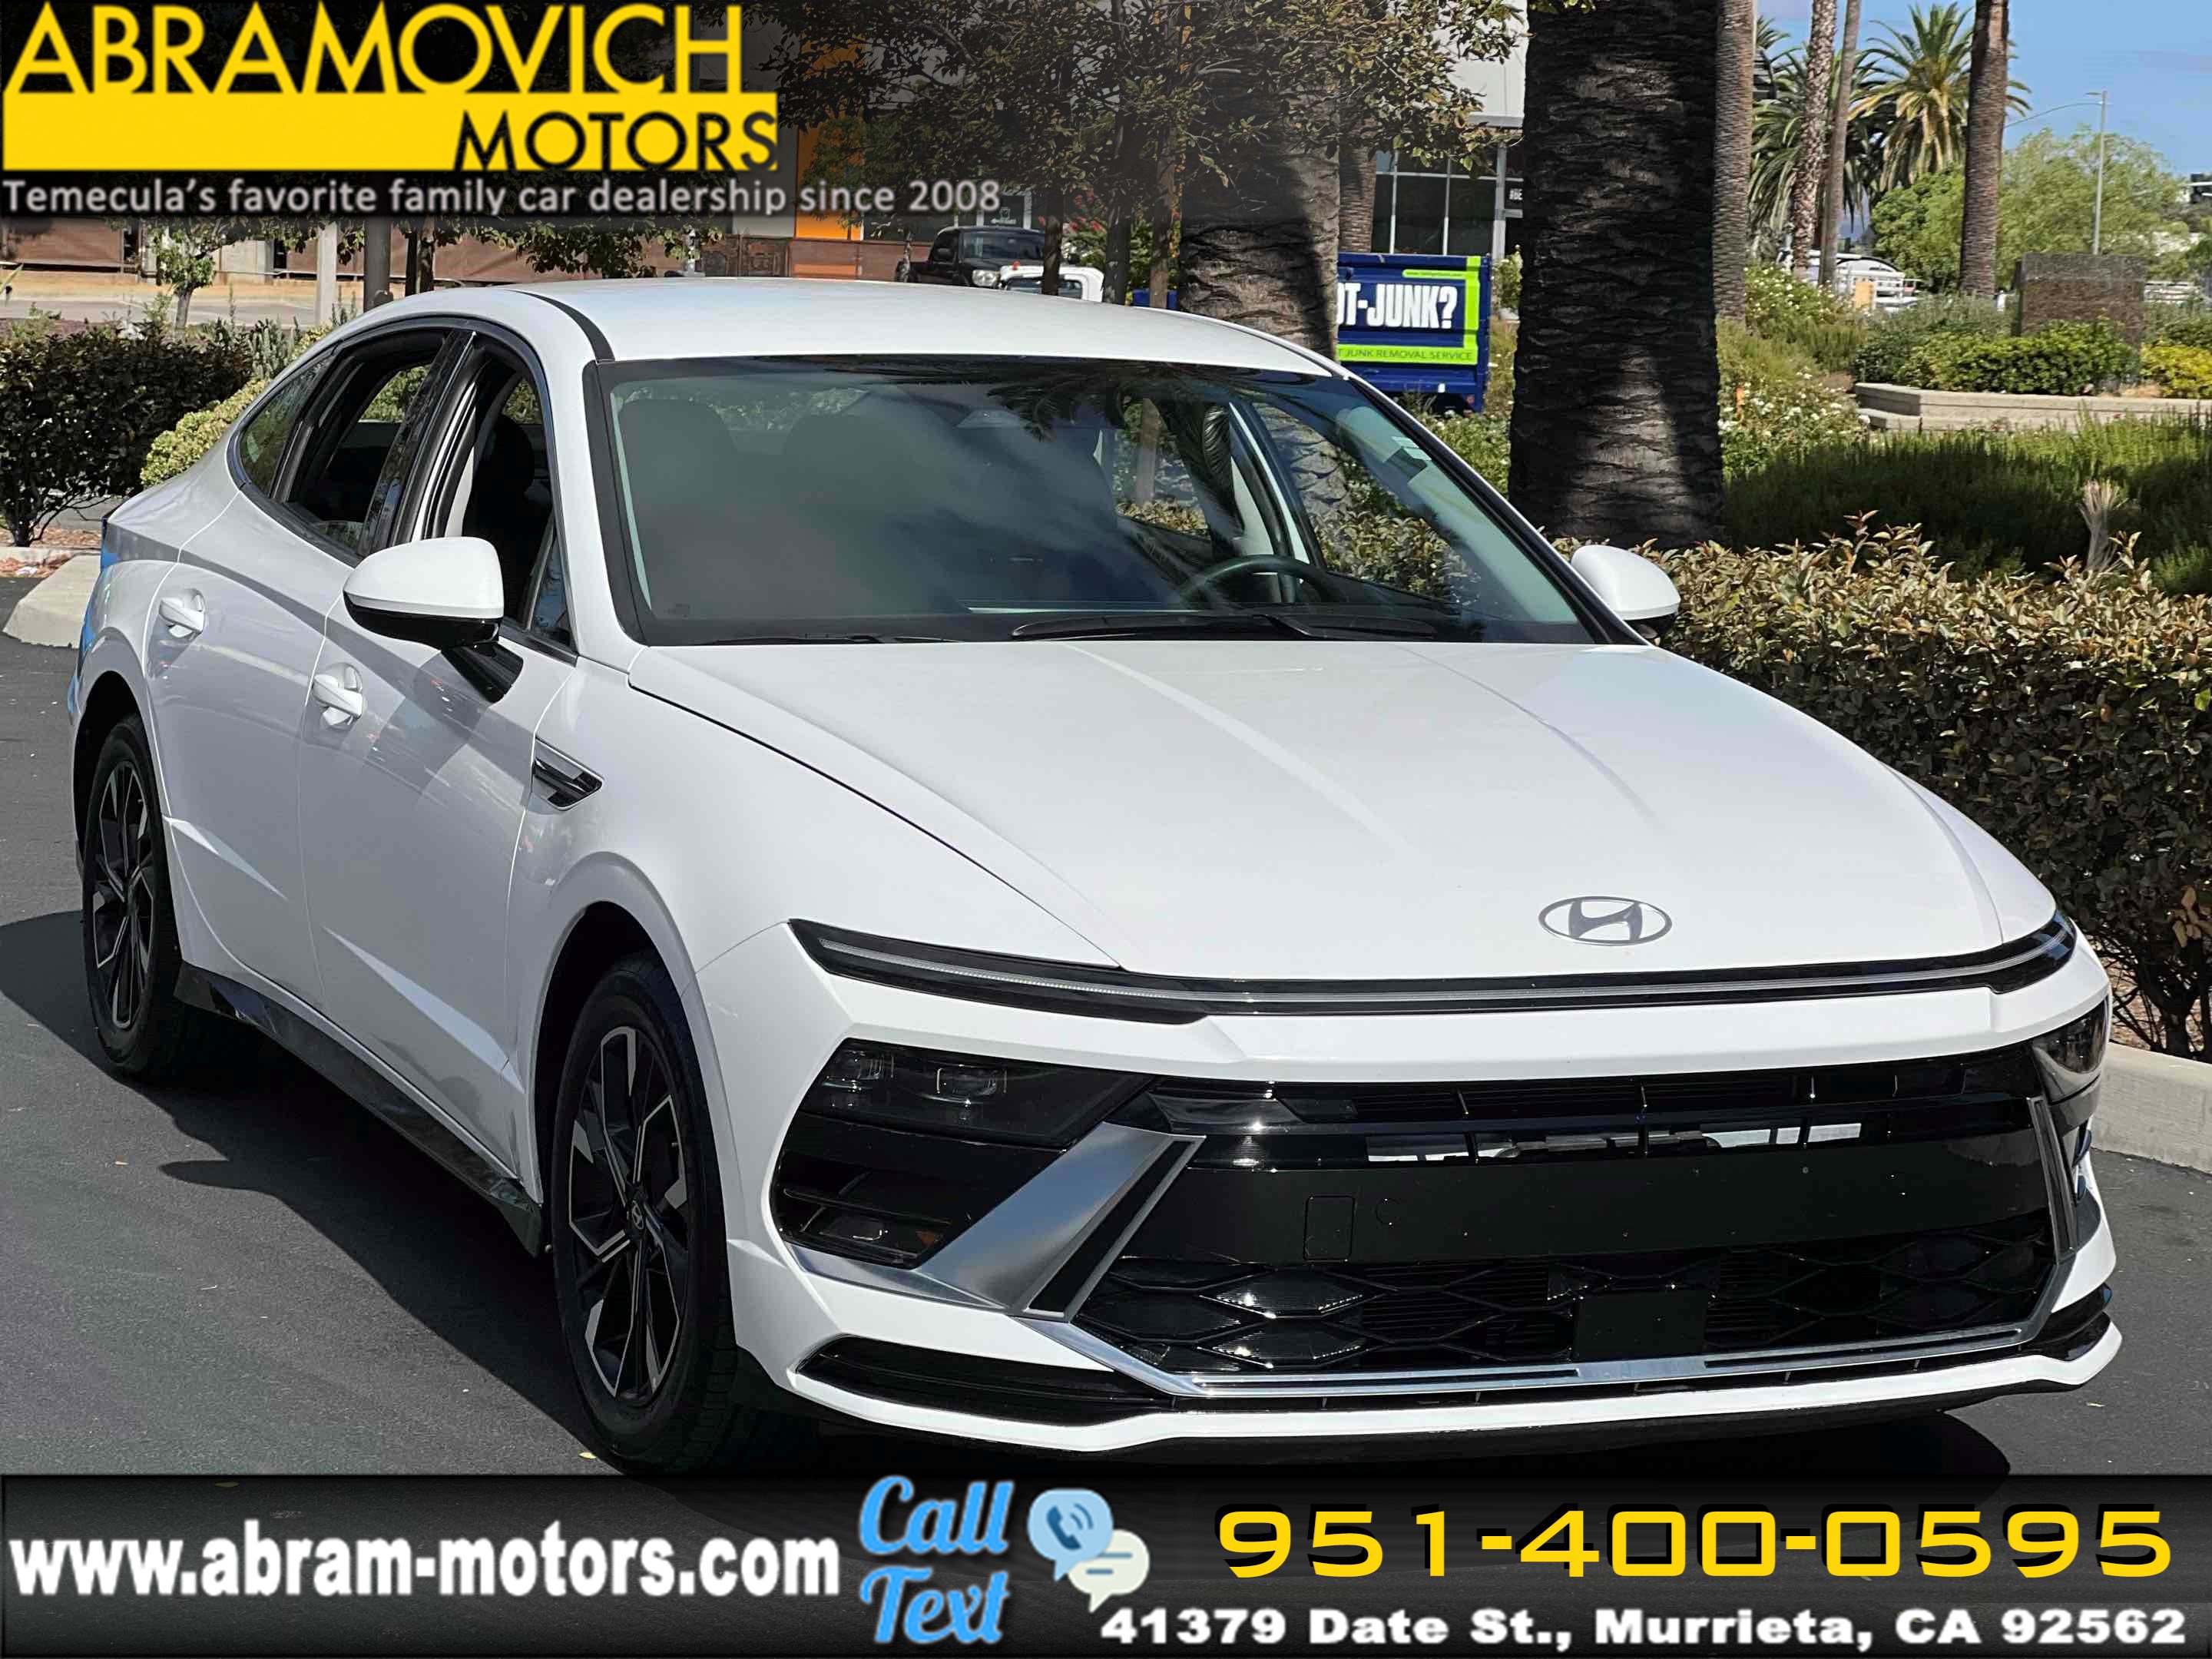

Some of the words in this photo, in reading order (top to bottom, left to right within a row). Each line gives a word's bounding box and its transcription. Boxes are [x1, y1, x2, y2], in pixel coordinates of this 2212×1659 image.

[1346, 349, 1373, 358] JUNK
[1376, 350, 1427, 359] REMOVAL
[1430, 352, 1472, 361] SERVICE
